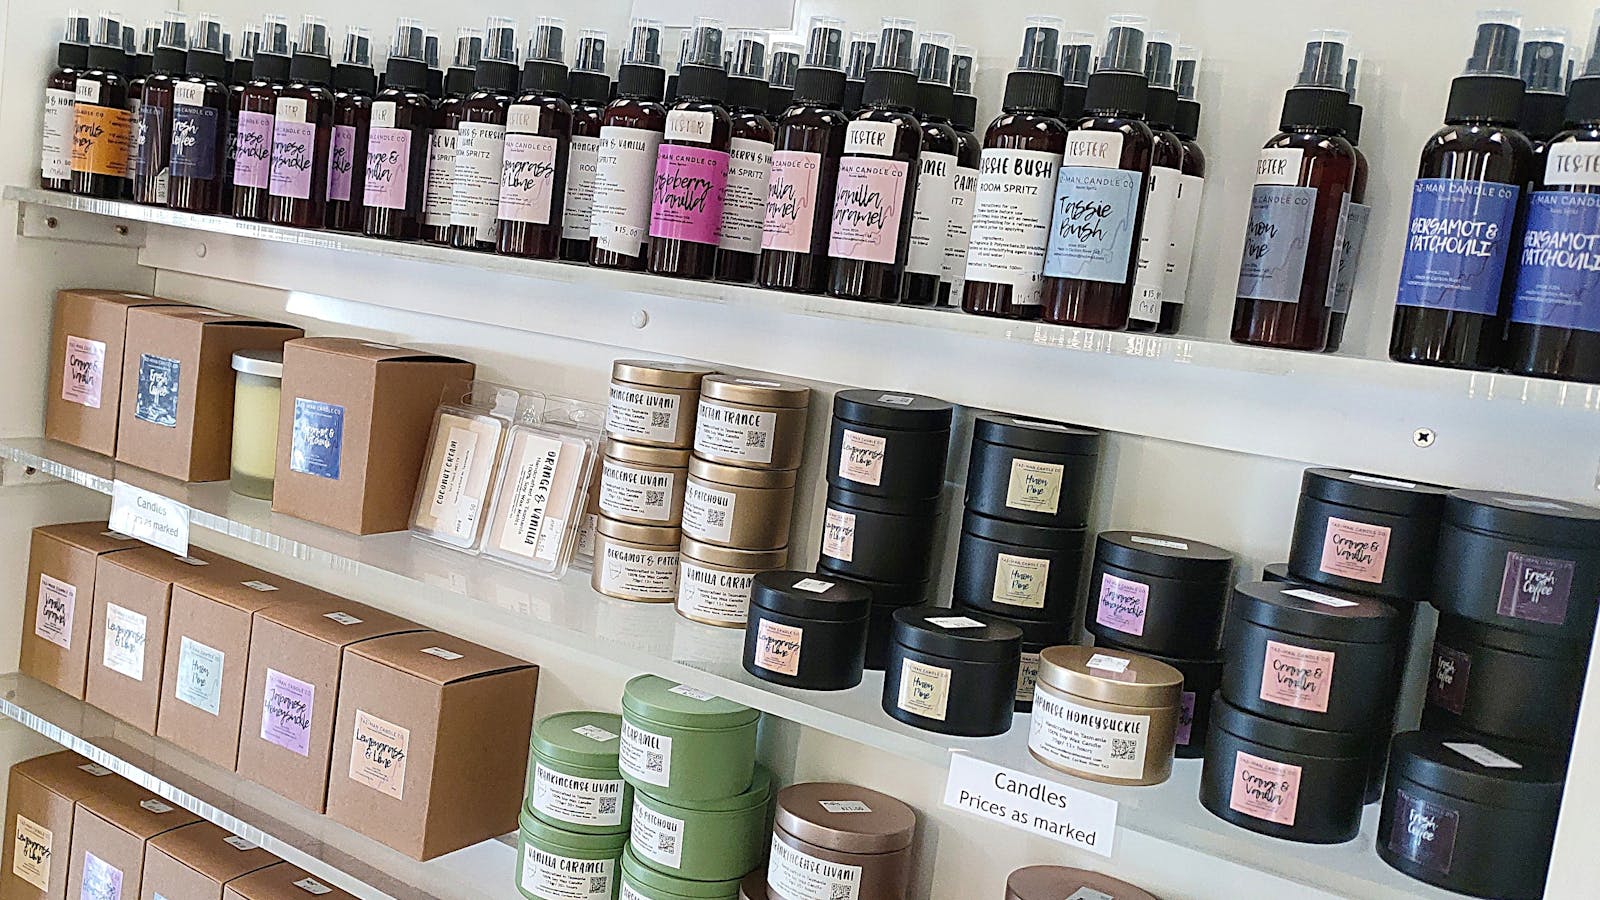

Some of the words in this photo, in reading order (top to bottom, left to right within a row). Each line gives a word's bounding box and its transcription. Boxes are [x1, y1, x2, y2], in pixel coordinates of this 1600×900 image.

[479, 130, 505, 142] PERSIA
[850, 130, 885, 147] TESTER
[466, 150, 490, 159] SPRITZ
[515, 142, 541, 151] CANDLE
[618, 139, 646, 152] VANILLA
[1069, 141, 1109, 158] TESTER
[389, 151, 399, 163] &
[676, 155, 704, 165] CANDLE
[804, 162, 815, 170] CO
[1557, 155, 1600, 173] TESTE
[580, 164, 597, 172] ROO
[737, 168, 763, 179] SPRITZ
[855, 166, 889, 176] CANDLE
[1014, 158, 1053, 179] BUSH
[1004, 184, 1038, 195] SPRITZ
[1084, 177, 1120, 187] CANDLE
[1450, 184, 1494, 198] CANDLE
[1499, 189, 1512, 199] CO
[1059, 196, 1113, 220] Tassie
[1561, 196, 1600, 207] CANDL
[1059, 219, 1108, 242] Bush
[1411, 217, 1485, 237] BERGAMOT
[1486, 224, 1498, 240] &
[1409, 235, 1491, 257] PATCHOULI
[1524, 230, 1595, 251] BERGAMOT
[724, 410, 761, 427] TRANCE
[437, 467, 451, 505] COCONUT
[447, 440, 458, 468] CREAM
[542, 451, 557, 492] ORANGE
[137, 496, 167, 516] Candles
[534, 494, 546, 505] &
[153, 522, 178, 537] marked
[524, 507, 543, 545] VANILLA
[1333, 533, 1368, 551] Orange
[1370, 541, 1379, 552] &
[607, 549, 645, 564] BERGAMOT
[647, 554, 654, 567] &
[1337, 545, 1372, 565] Vanilla
[687, 568, 716, 586] VANILLA
[1524, 568, 1555, 585] Fresh
[1523, 580, 1553, 604] Coffee
[1273, 658, 1312, 677] Orange
[1315, 667, 1322, 678] &
[1067, 709, 1141, 735] HONEYSUCKLE
[356, 727, 405, 761] Lemongrass
[537, 766, 589, 792] FRANKINCENSE
[592, 782, 619, 794] LIVANI
[1242, 770, 1279, 792] Orange
[1281, 780, 1289, 792] &
[995, 772, 1068, 809] Candles
[959, 790, 1007, 817] Prices
[1011, 810, 1028, 824] as
[1034, 815, 1096, 846] marked
[528, 848, 556, 869] VANILLA
[560, 857, 605, 873] CARAMEL
[824, 867, 855, 882] LIVANI
